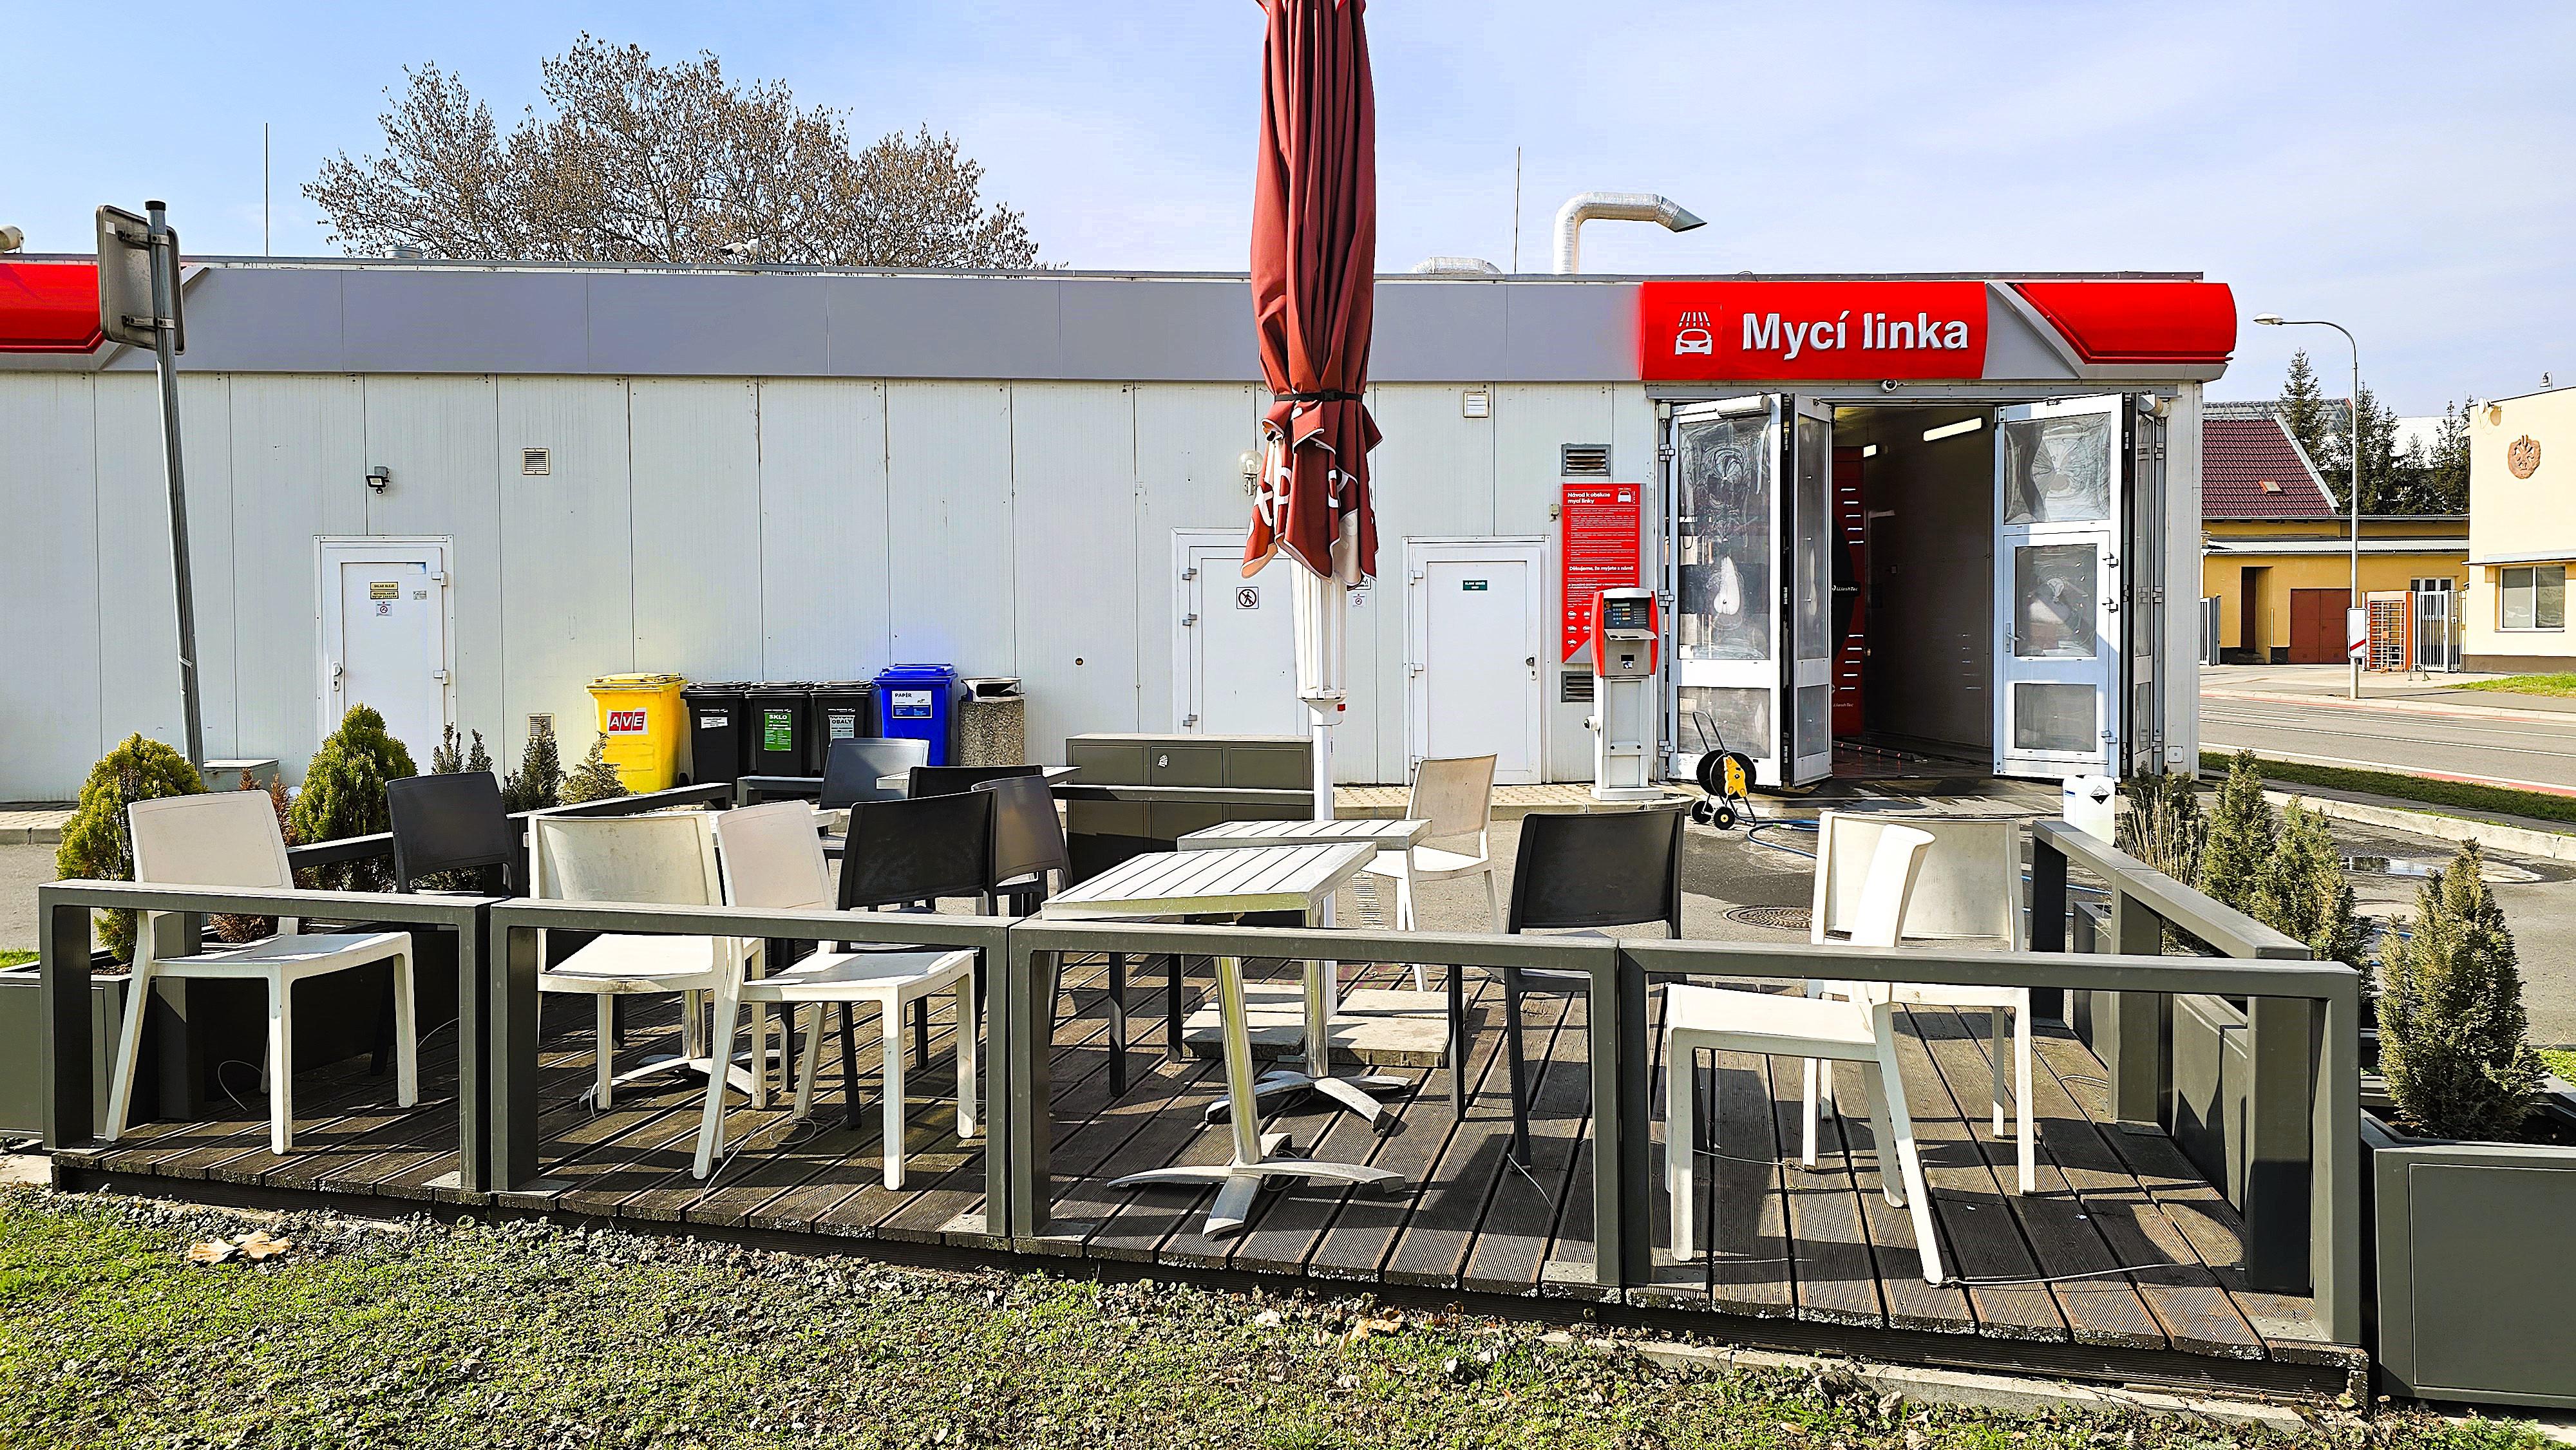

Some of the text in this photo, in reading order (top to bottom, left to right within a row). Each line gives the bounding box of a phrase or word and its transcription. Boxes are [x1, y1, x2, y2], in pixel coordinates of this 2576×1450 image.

[1743, 310, 1969, 360] Mycí linka
[609, 716, 643, 727] AVE
